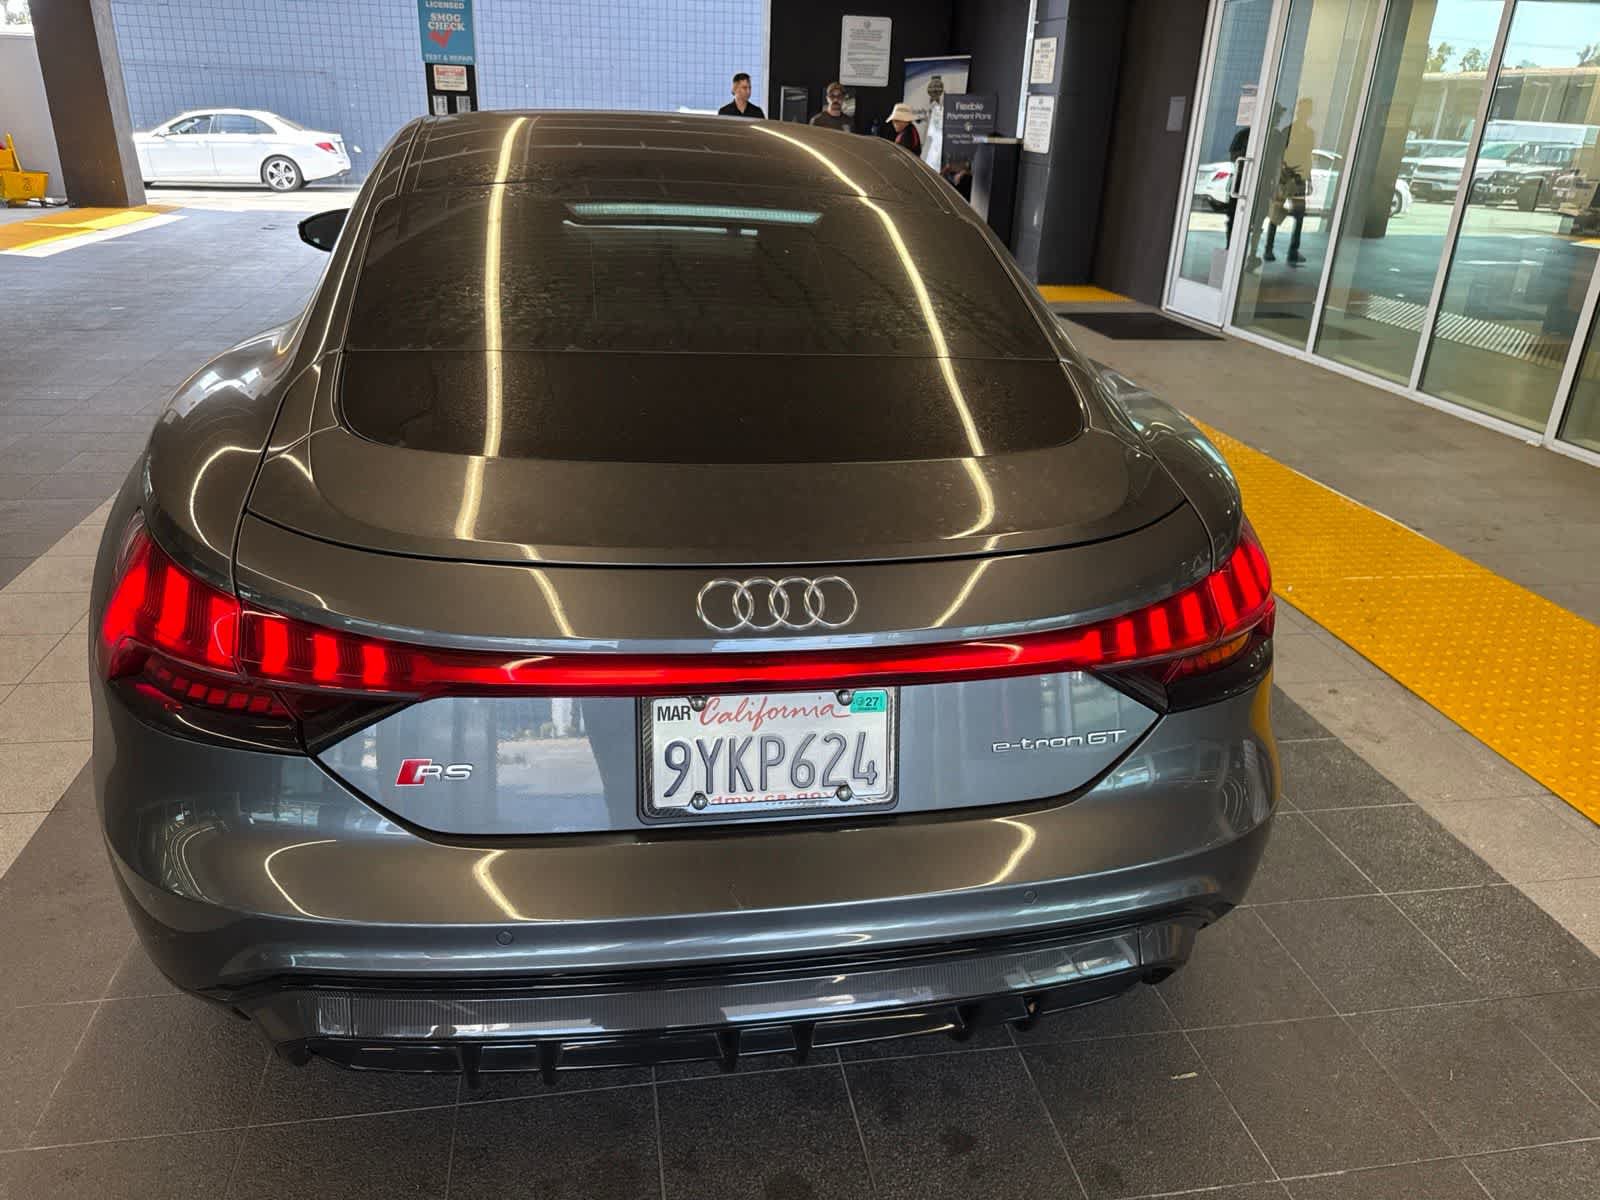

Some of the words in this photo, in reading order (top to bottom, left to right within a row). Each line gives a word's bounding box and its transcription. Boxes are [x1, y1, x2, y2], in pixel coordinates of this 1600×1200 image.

[430, 13, 461, 22] SMOG
[428, 21, 465, 31] CHECK
[955, 102, 984, 111] Flexible
[947, 112, 974, 121] Payment
[975, 112, 992, 120] Plans
[657, 706, 691, 721] MAR
[699, 696, 851, 732] California
[865, 696, 880, 707] 27
[992, 736, 1083, 753] e-tron
[1087, 729, 1127, 745] GT
[664, 731, 878, 798] 9YKP624
[412, 763, 473, 784] RS
[711, 791, 834, 805] dmvcagov
